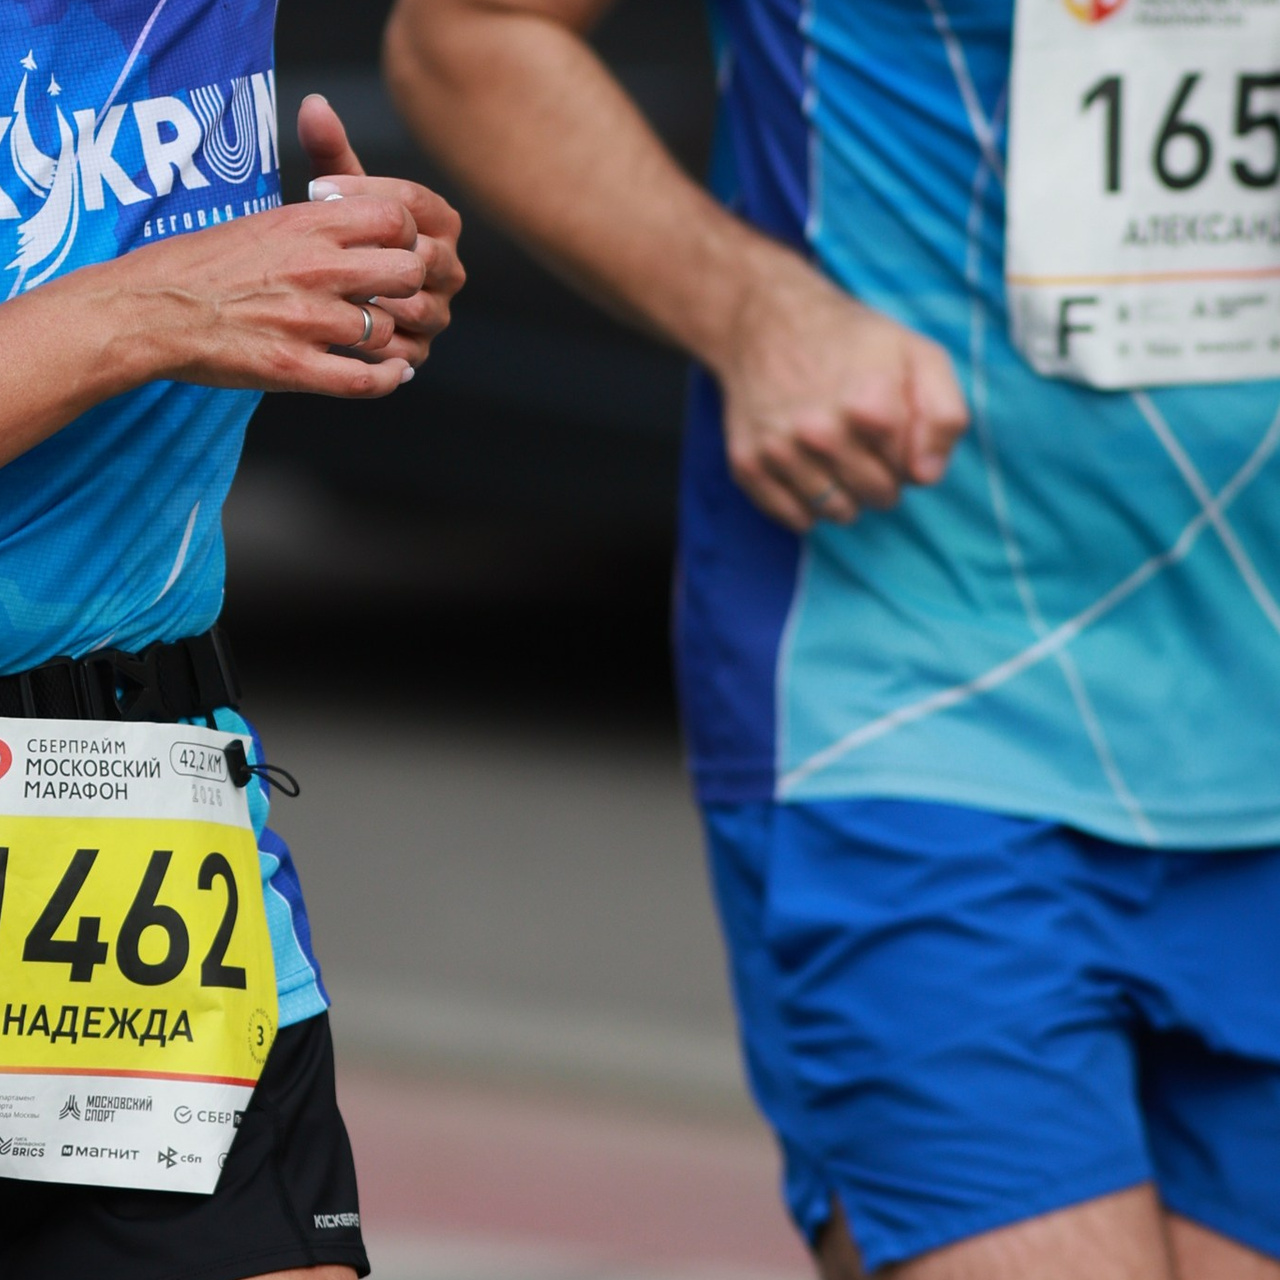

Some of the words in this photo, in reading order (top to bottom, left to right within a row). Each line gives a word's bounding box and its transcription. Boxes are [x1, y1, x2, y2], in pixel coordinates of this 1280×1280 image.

[1080, 72, 1280, 195] 165
[1057, 296, 1098, 358] F
[27, 737, 126, 754] СБЕРПРАЙМ
[25, 757, 161, 778] МОСКОВСКИЙ
[179, 749, 205, 770] 42,2
[207, 752, 222, 774] КМ
[24, 781, 128, 800] МАРАФОН
[2, 1003, 194, 1047] НАДЕЖДА
[256, 1025, 264, 1047] 3
[86, 1095, 153, 1112] МОСКОВСКИЙ
[84, 1109, 116, 1123] СПОРТ
[197, 1110, 232, 1124] СБЕР
[12, 1147, 45, 1158] BRICS
